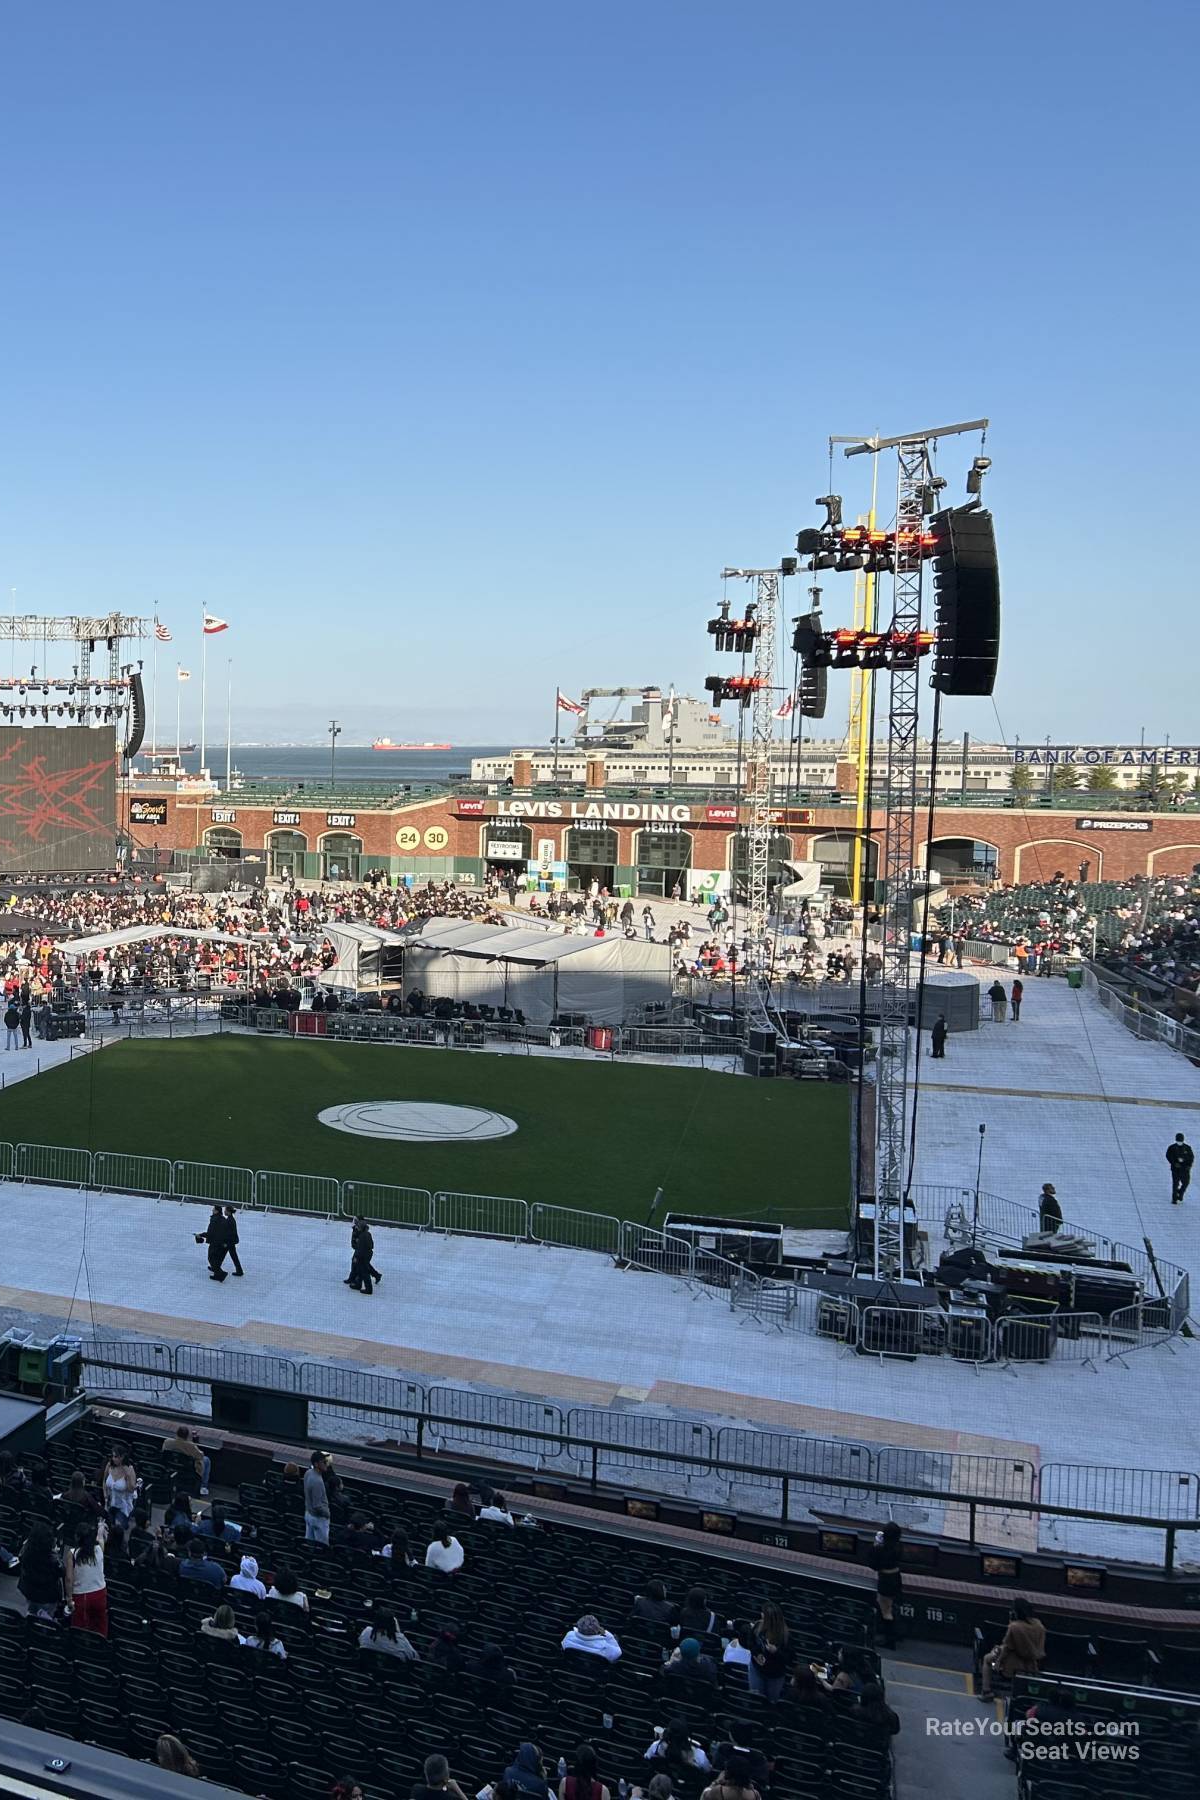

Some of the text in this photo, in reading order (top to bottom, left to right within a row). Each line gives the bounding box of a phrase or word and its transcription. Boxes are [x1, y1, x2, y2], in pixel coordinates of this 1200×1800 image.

[1014, 750, 1076, 764] BANK
[1085, 750, 1114, 764] OF
[571, 803, 690, 821] LANDING
[215, 813, 231, 823] EXIT
[278, 814, 295, 824] EXIT
[332, 816, 349, 826] EXIT
[495, 817, 515, 827] EXIT
[580, 820, 601, 830] EXIT
[651, 822, 675, 833] EXIT
[1093, 821, 1149, 830] PRIZEPICKS
[401, 833, 444, 844] 24 30
[775, 1536, 789, 1548] 121
[899, 1606, 943, 1622] 121 119
